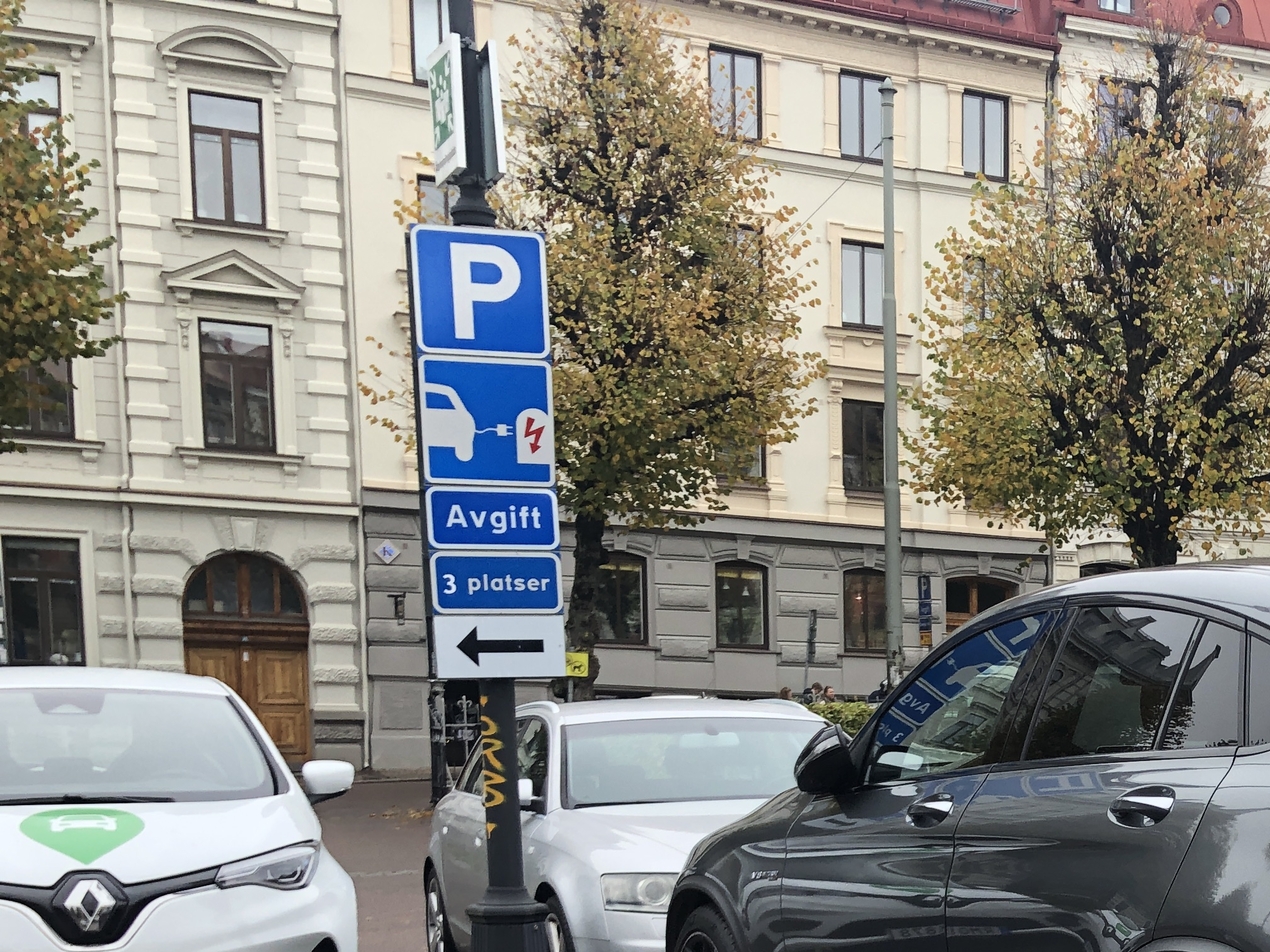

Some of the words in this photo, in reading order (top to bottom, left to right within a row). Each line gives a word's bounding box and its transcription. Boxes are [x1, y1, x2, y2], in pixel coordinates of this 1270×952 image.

[450, 241, 522, 340] P
[445, 504, 541, 534] Avgift
[442, 573, 457, 595] 3
[467, 573, 551, 595] platser
[921, 577, 928, 599] P
